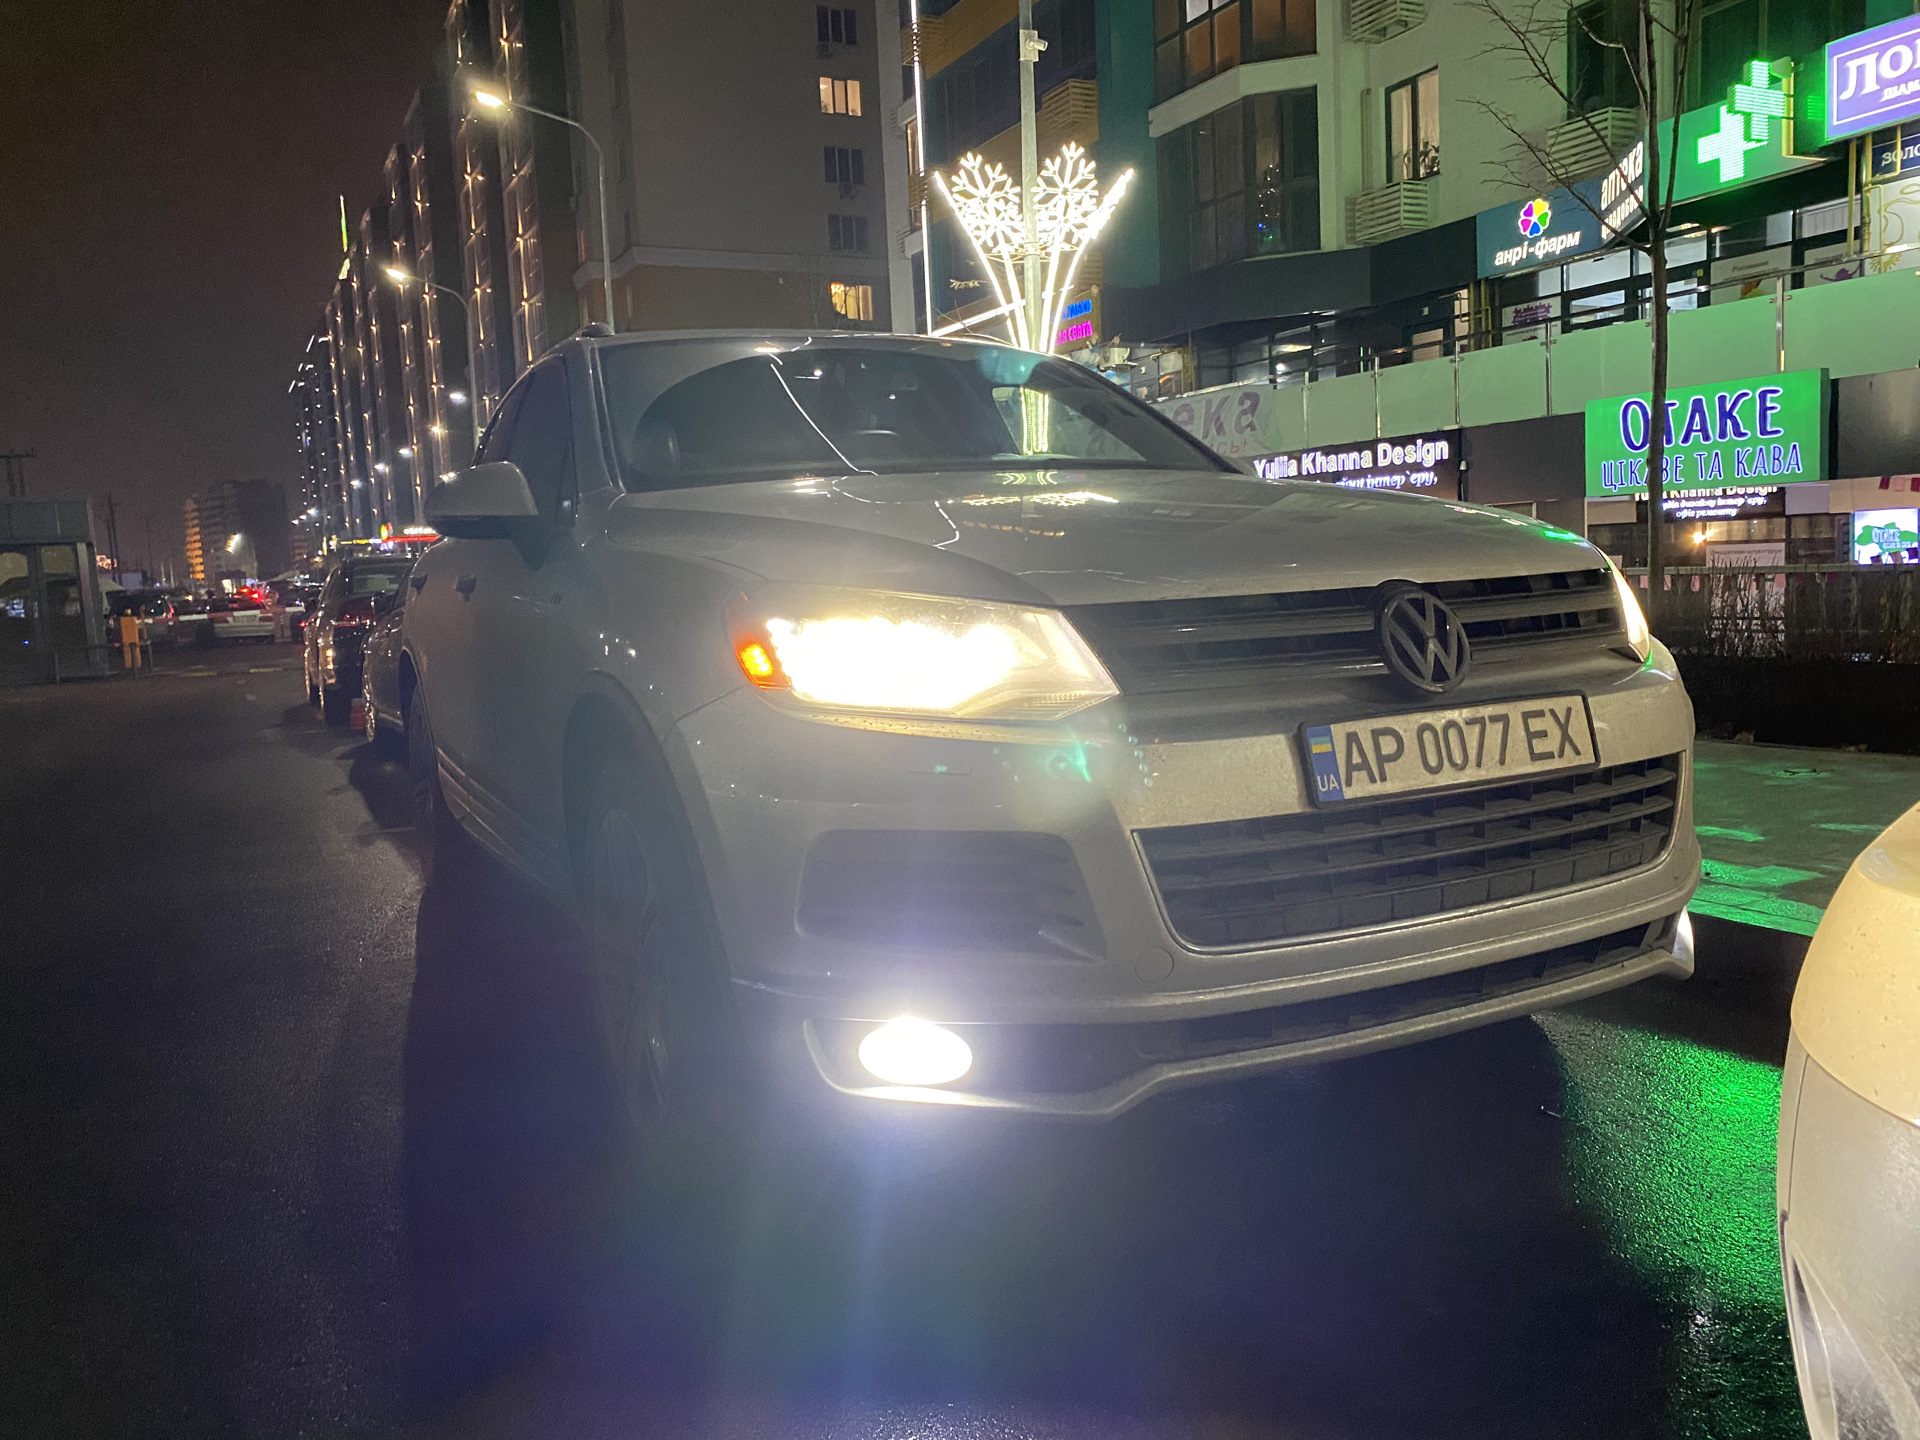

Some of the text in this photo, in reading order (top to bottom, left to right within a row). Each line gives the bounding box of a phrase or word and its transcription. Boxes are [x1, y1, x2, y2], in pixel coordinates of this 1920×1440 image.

[1495, 231, 1581, 267] анрі-фарм
[1170, 391, 1261, 440] ека
[1620, 386, 1783, 453] ОТАКЕ
[1253, 438, 1449, 479] Yuliia Khanna Design
[1602, 442, 1803, 492] ЦІКВЕ ТА КАВА
[1345, 706, 1582, 787] AP 0077 EX
[1317, 774, 1340, 792] UA
